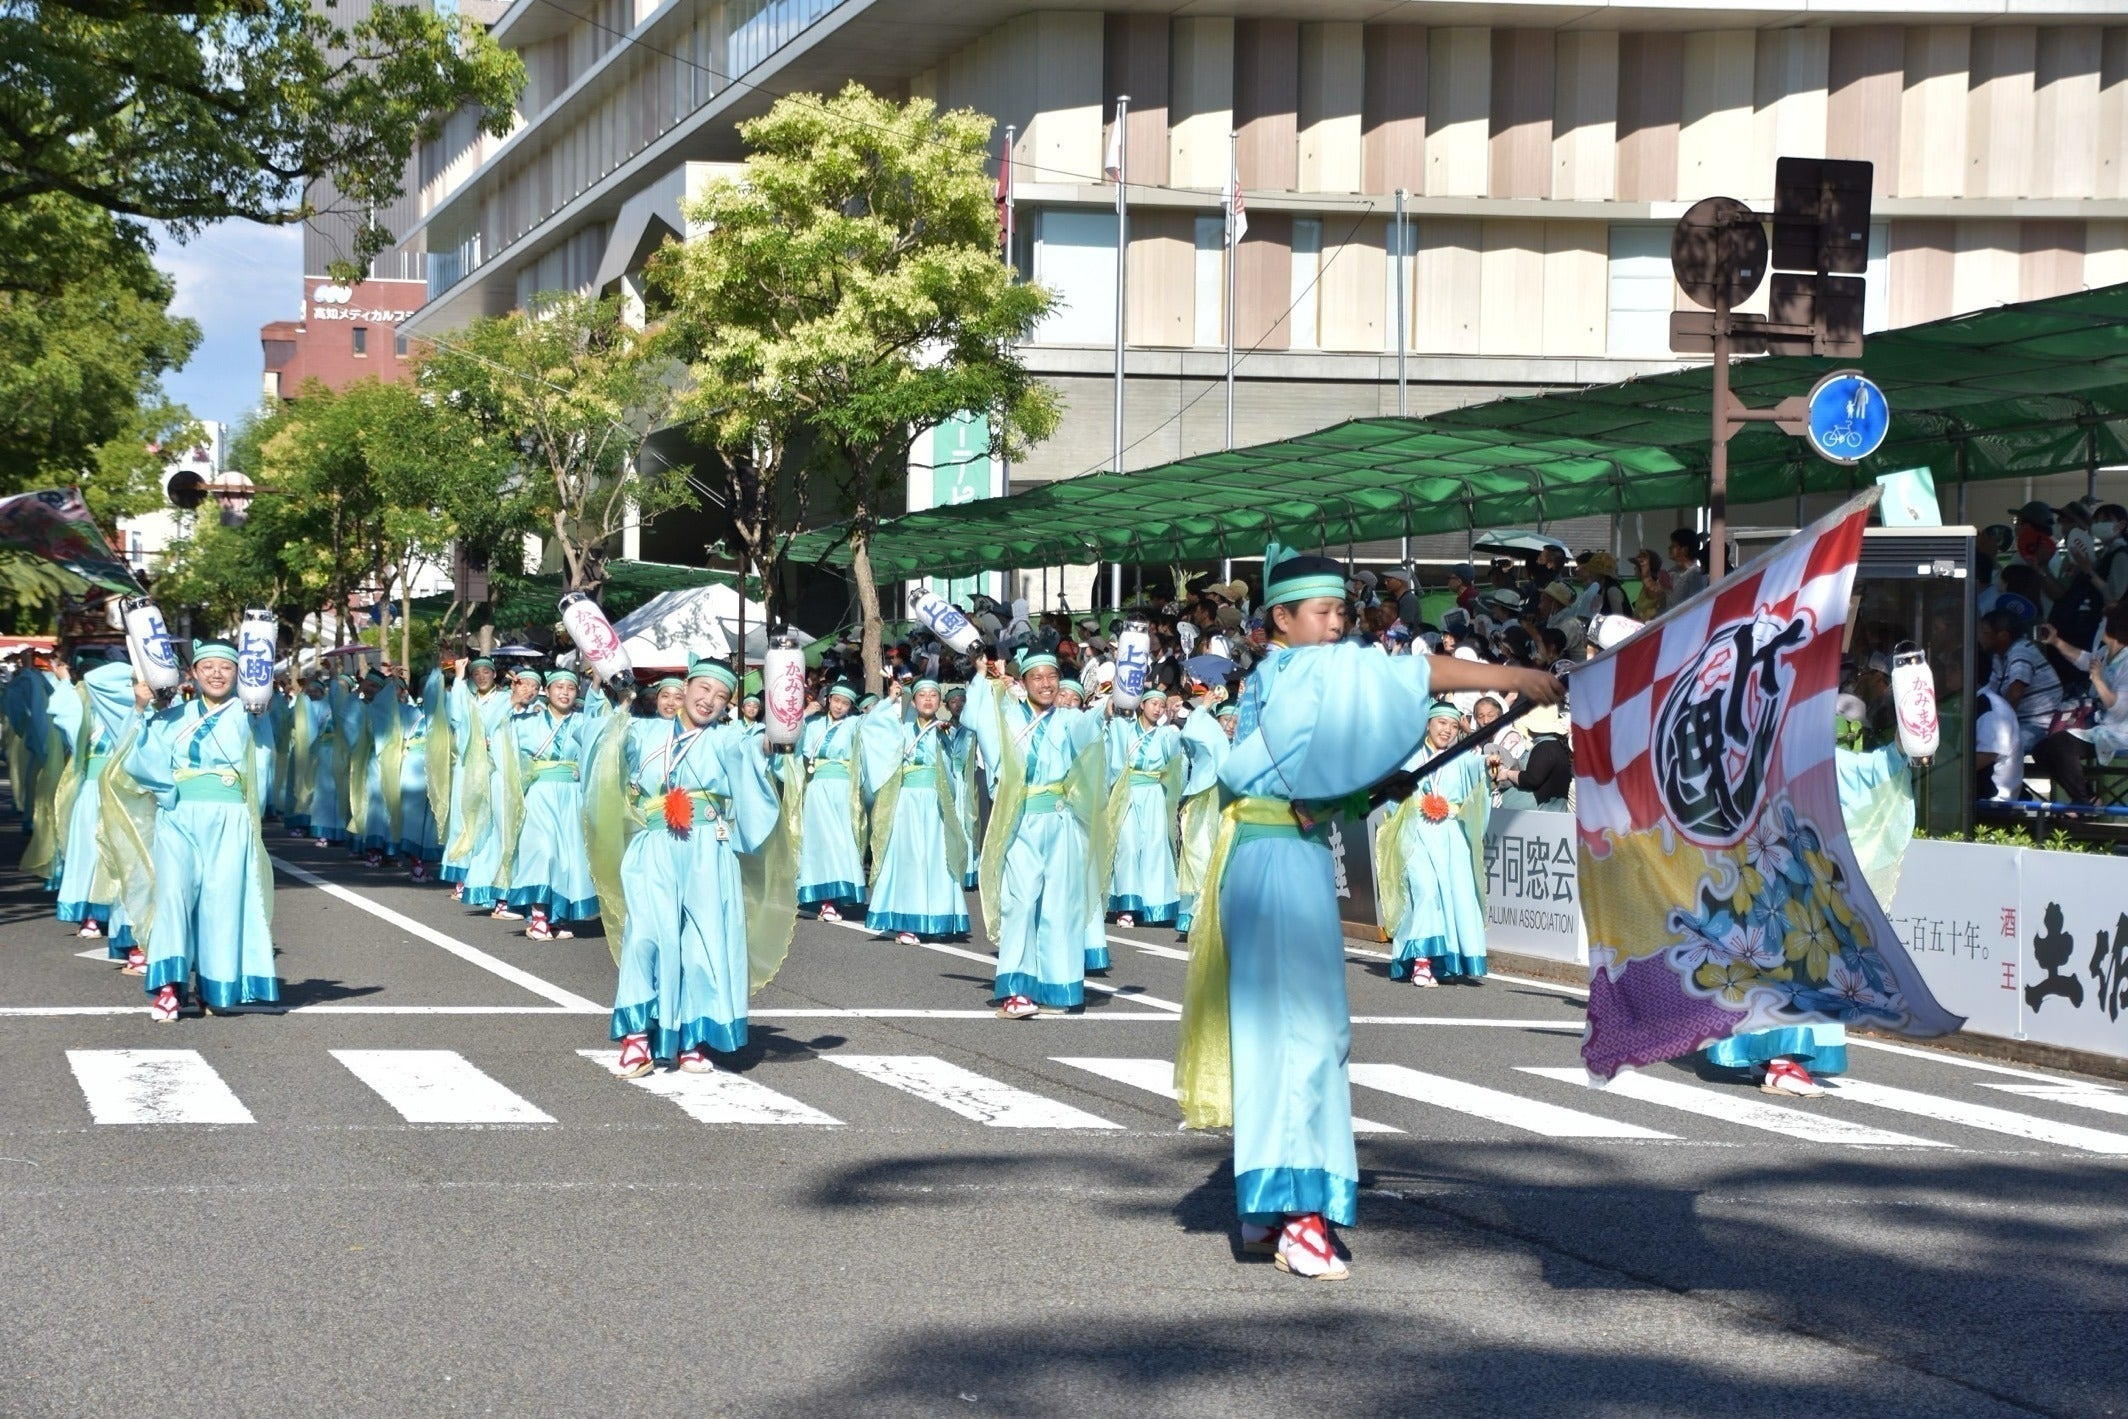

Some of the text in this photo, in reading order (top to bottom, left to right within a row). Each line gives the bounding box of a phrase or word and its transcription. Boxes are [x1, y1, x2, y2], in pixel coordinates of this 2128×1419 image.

[239, 632, 275, 687] 上町
[575, 610, 616, 662] かみまち
[784, 660, 801, 733] かみまち
[1912, 676, 1934, 744] かみまち
[1488, 905, 1575, 934] ALUMNI ASSOCIATION
